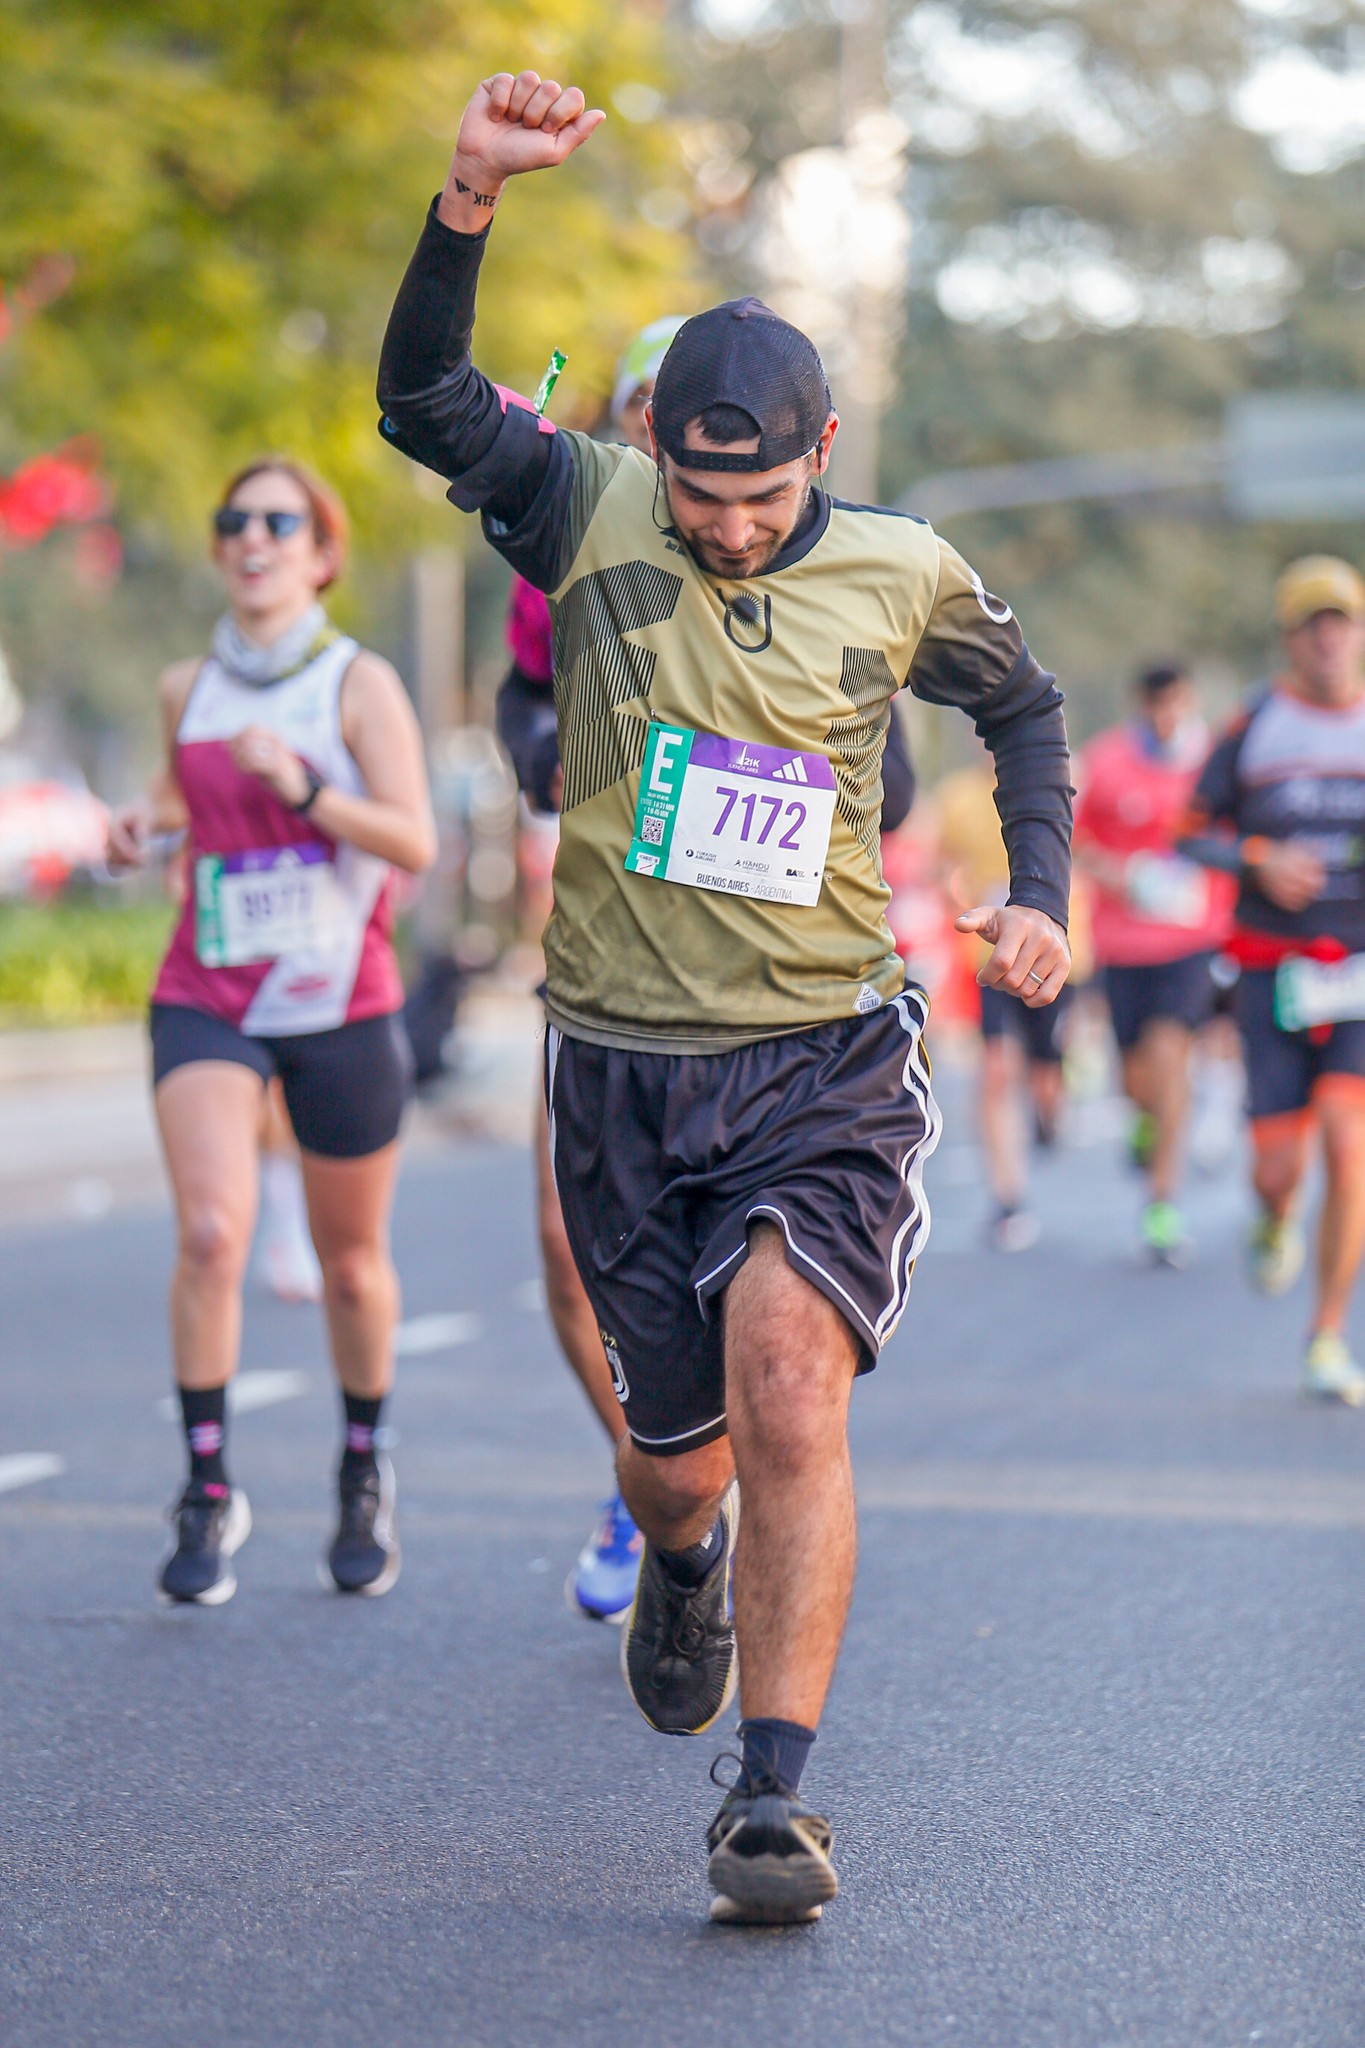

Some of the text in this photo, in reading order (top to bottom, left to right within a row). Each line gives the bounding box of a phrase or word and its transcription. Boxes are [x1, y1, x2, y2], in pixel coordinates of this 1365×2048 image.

[473, 192, 496, 208] 21K
[649, 731, 683, 794] E
[744, 757, 760, 768] 21K
[712, 786, 807, 850] 7172
[696, 873, 726, 889] BUENOS
[727, 878, 750, 893] AIRES
[754, 884, 792, 900] ARGENTINA
